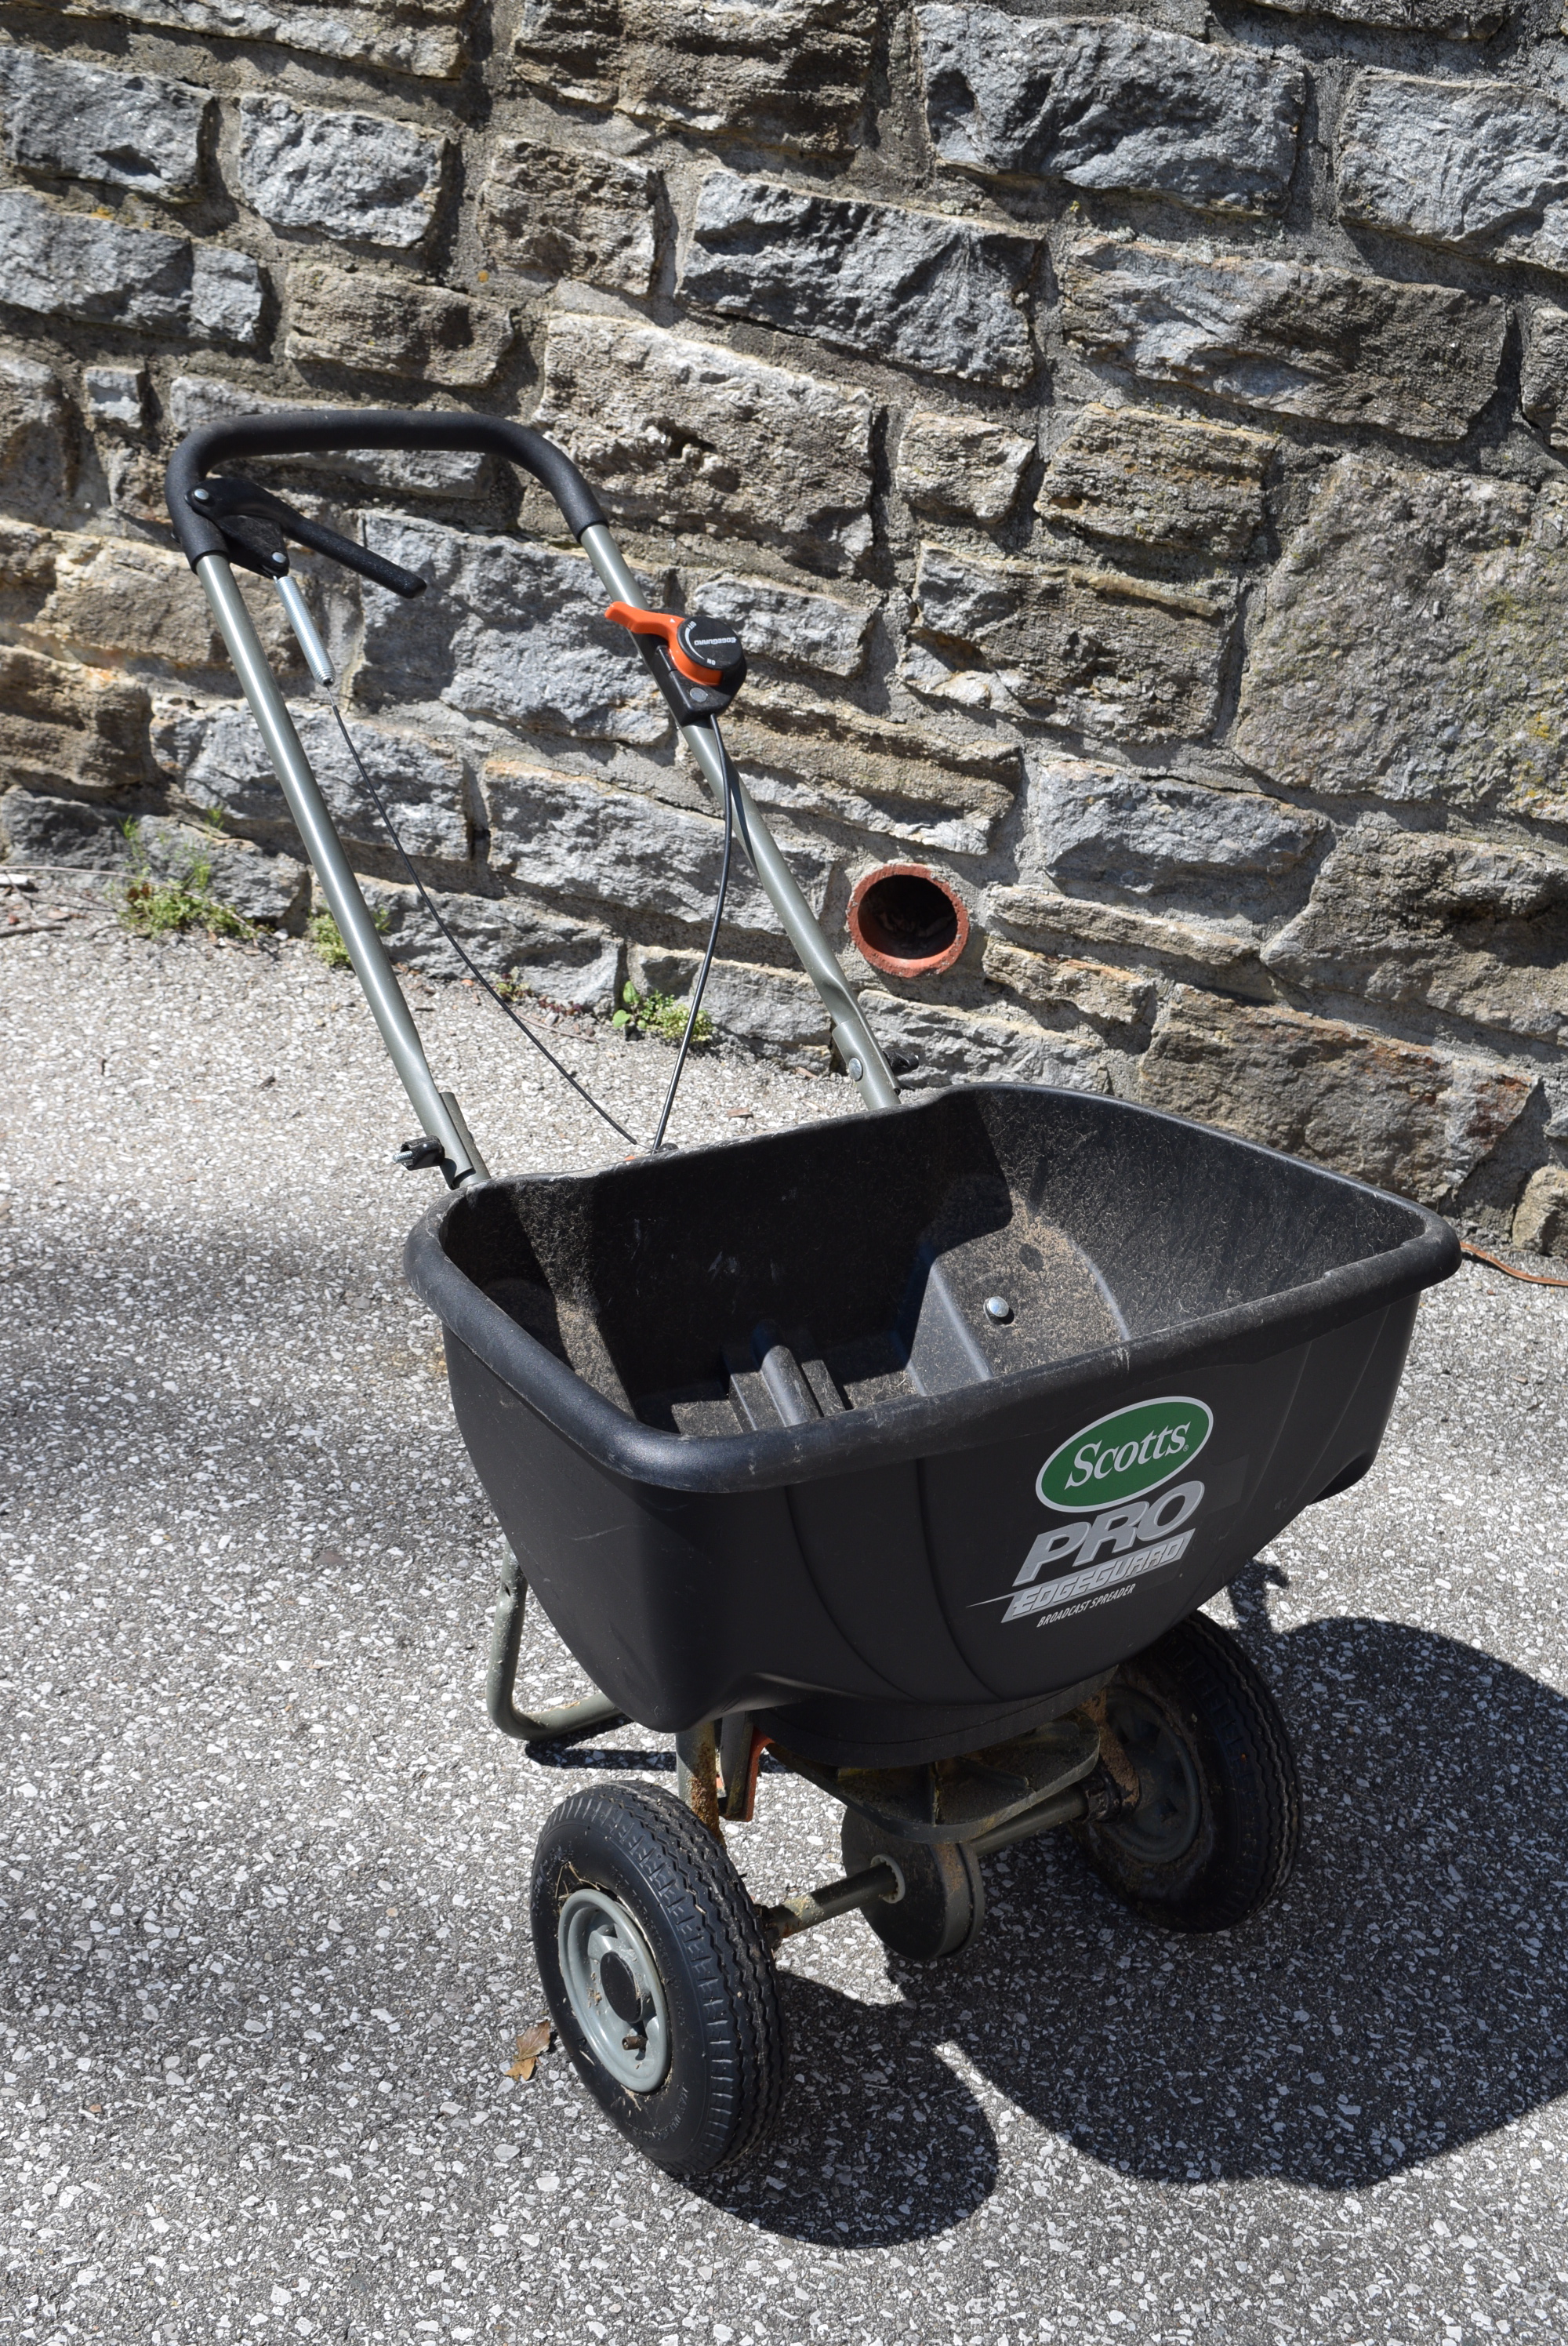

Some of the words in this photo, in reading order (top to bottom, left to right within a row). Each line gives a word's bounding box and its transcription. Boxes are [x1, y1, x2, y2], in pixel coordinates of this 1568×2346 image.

[1064, 1421, 1191, 1490] Scotts
[1012, 1480, 1205, 1587] PRO
[1011, 1538, 1185, 1617] EDGEGUARD
[1036, 1600, 1092, 1628] BROADCAST
[1089, 1583, 1136, 1609] SPREADER
